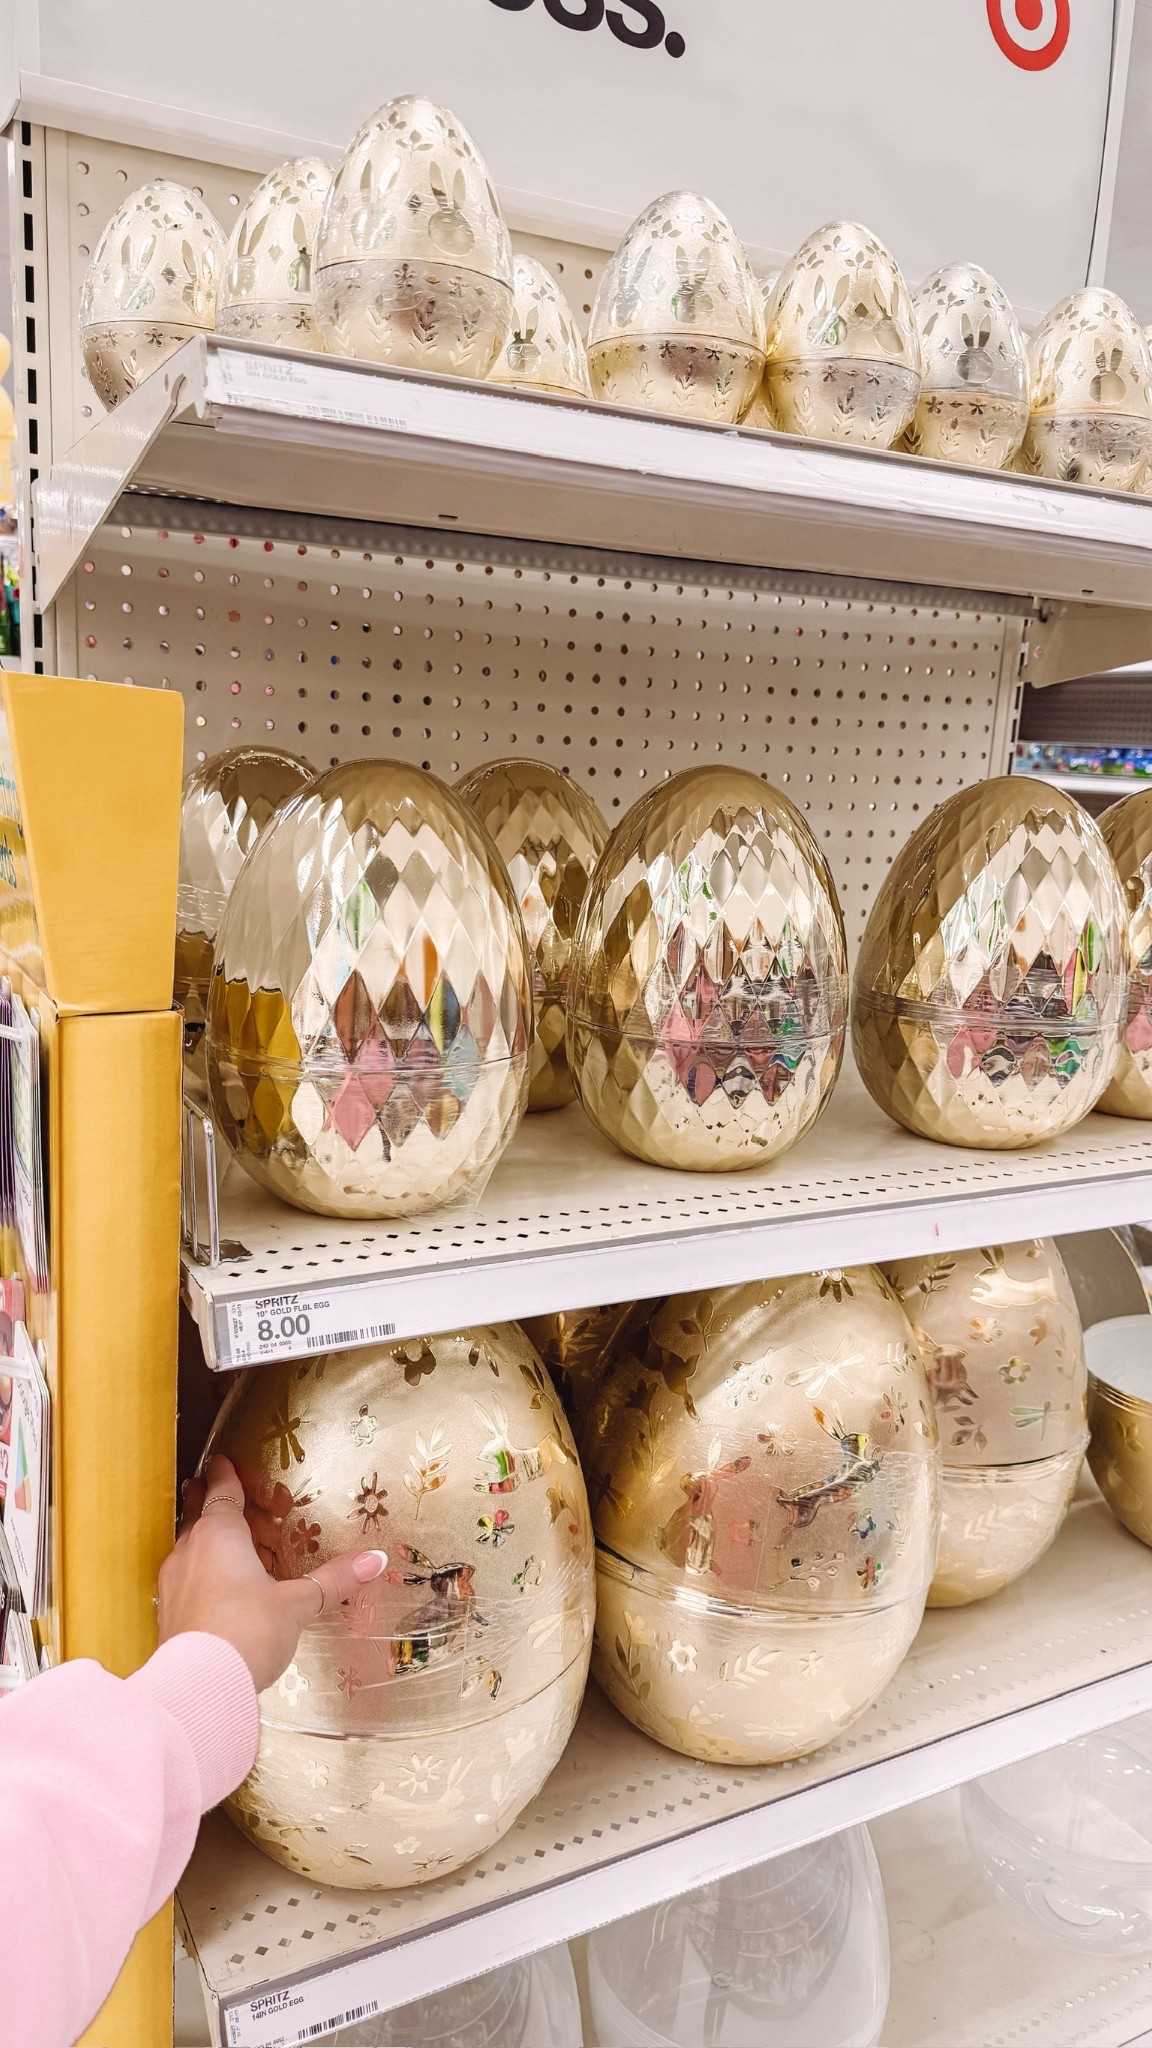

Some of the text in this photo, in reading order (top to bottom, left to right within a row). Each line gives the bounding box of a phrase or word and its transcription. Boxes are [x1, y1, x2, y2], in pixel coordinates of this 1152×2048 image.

[245, 361, 295, 376] SPRITZ
[262, 372, 288, 382] GOLD
[288, 376, 308, 385] EGG
[255, 1295, 299, 1309] SPRITZ
[269, 1307, 292, 1316] GOLD
[293, 1304, 312, 1312] FLBL
[313, 1301, 330, 1309] EGG
[258, 1314, 310, 1341] 8.00
[250, 1991, 290, 2012] SPRITZ
[252, 1996, 304, 2021] 14IN GOLD EGG
